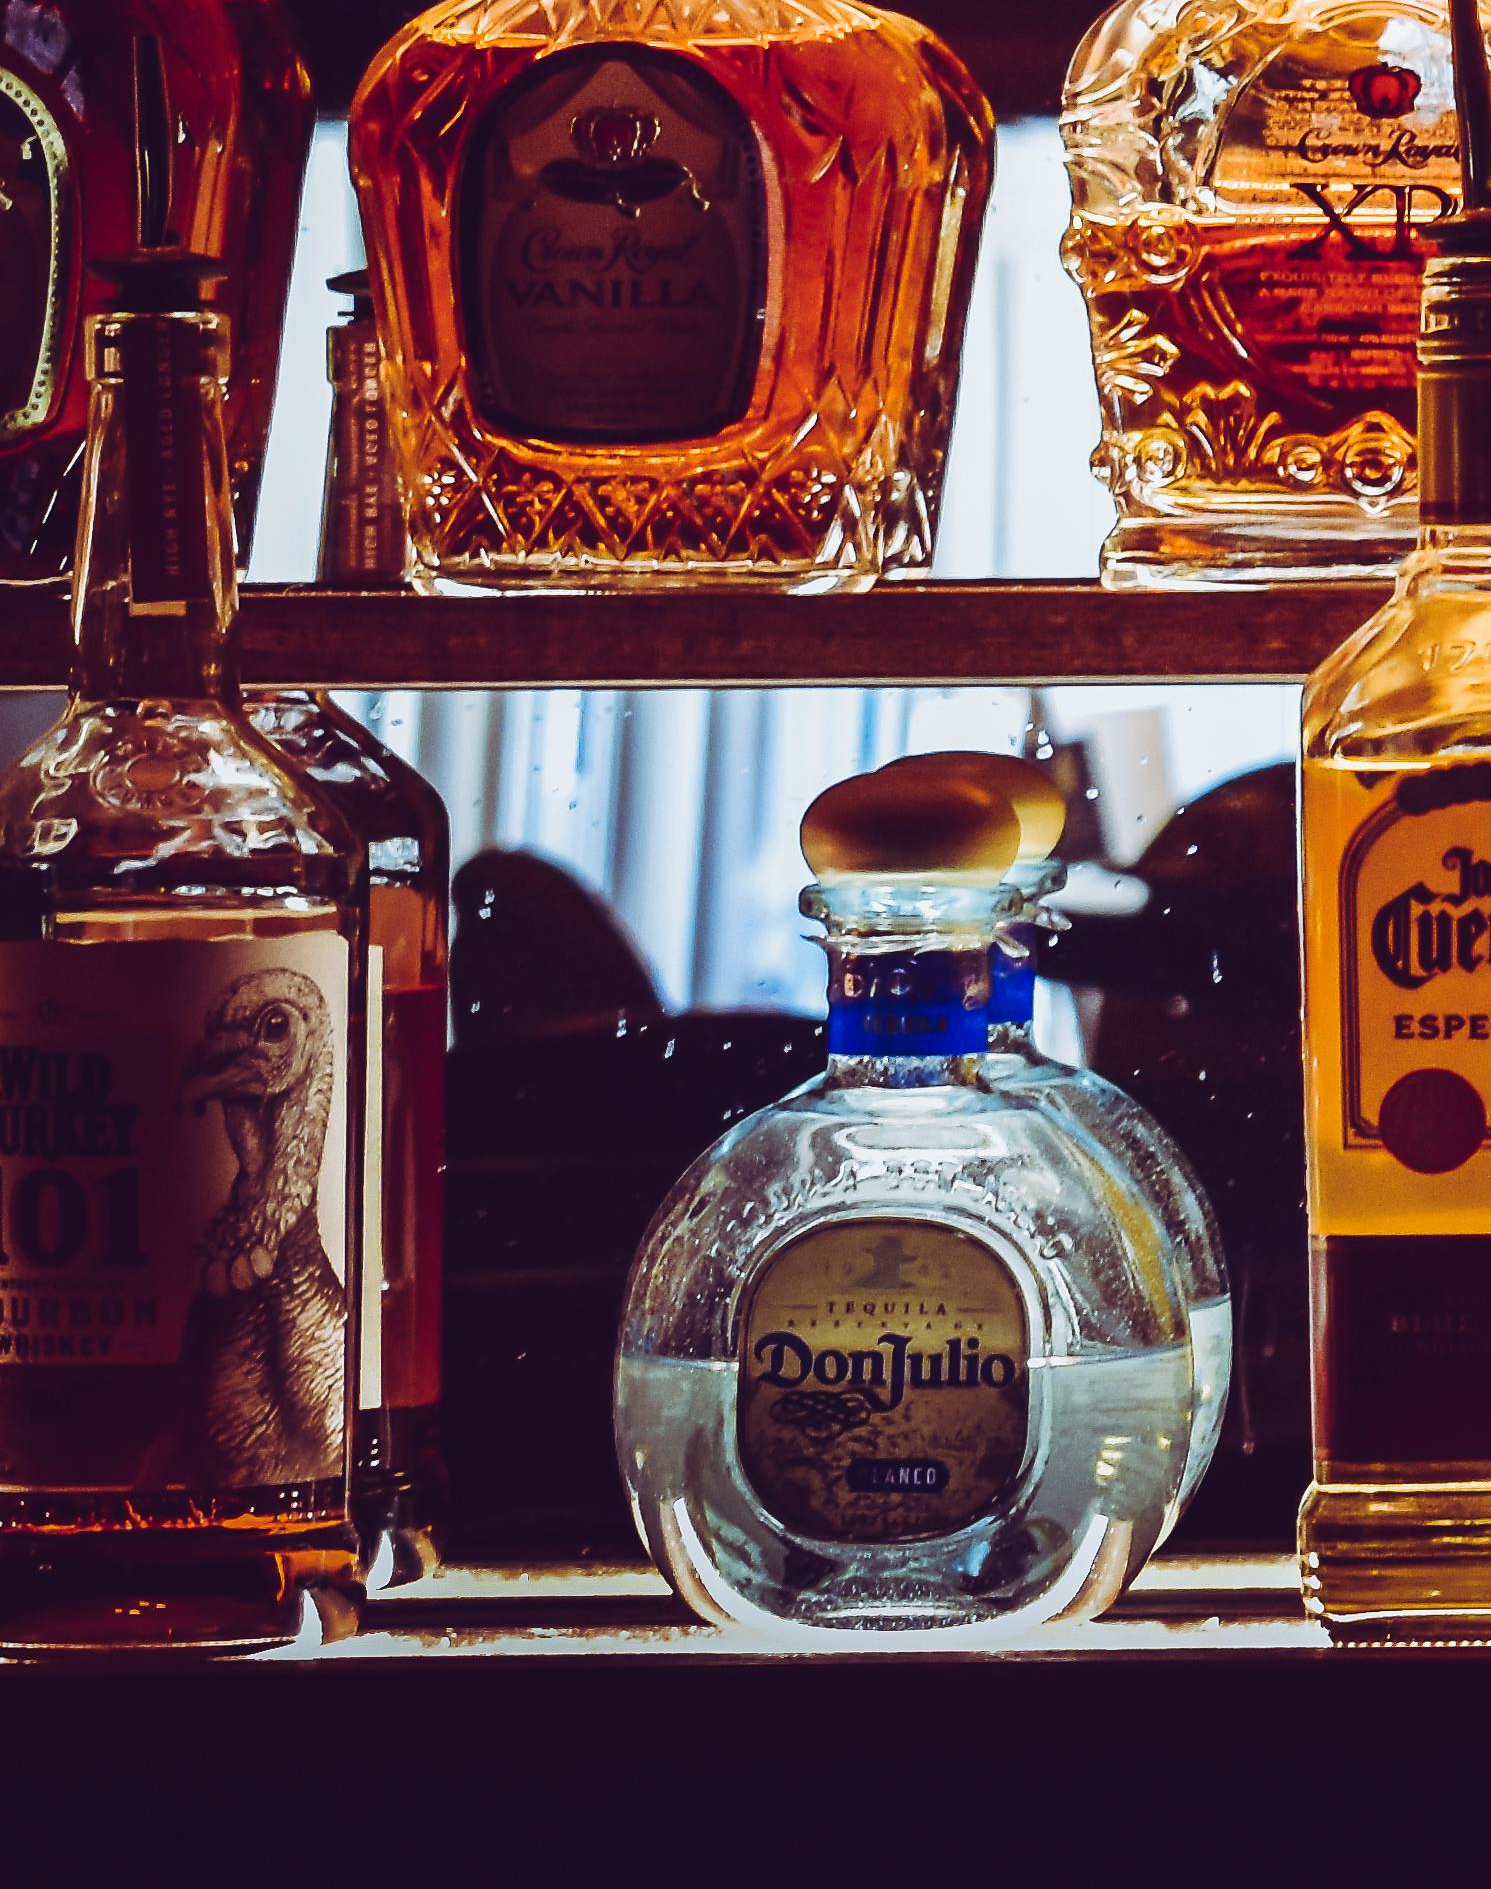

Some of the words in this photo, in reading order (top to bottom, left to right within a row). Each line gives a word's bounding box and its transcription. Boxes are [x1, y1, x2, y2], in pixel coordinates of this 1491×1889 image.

[1298, 128, 1381, 163] Crown
[506, 279, 718, 308] VANILLA
[0, 1105, 141, 1158] URKEY
[828, 1302, 947, 1315] TEQUILA
